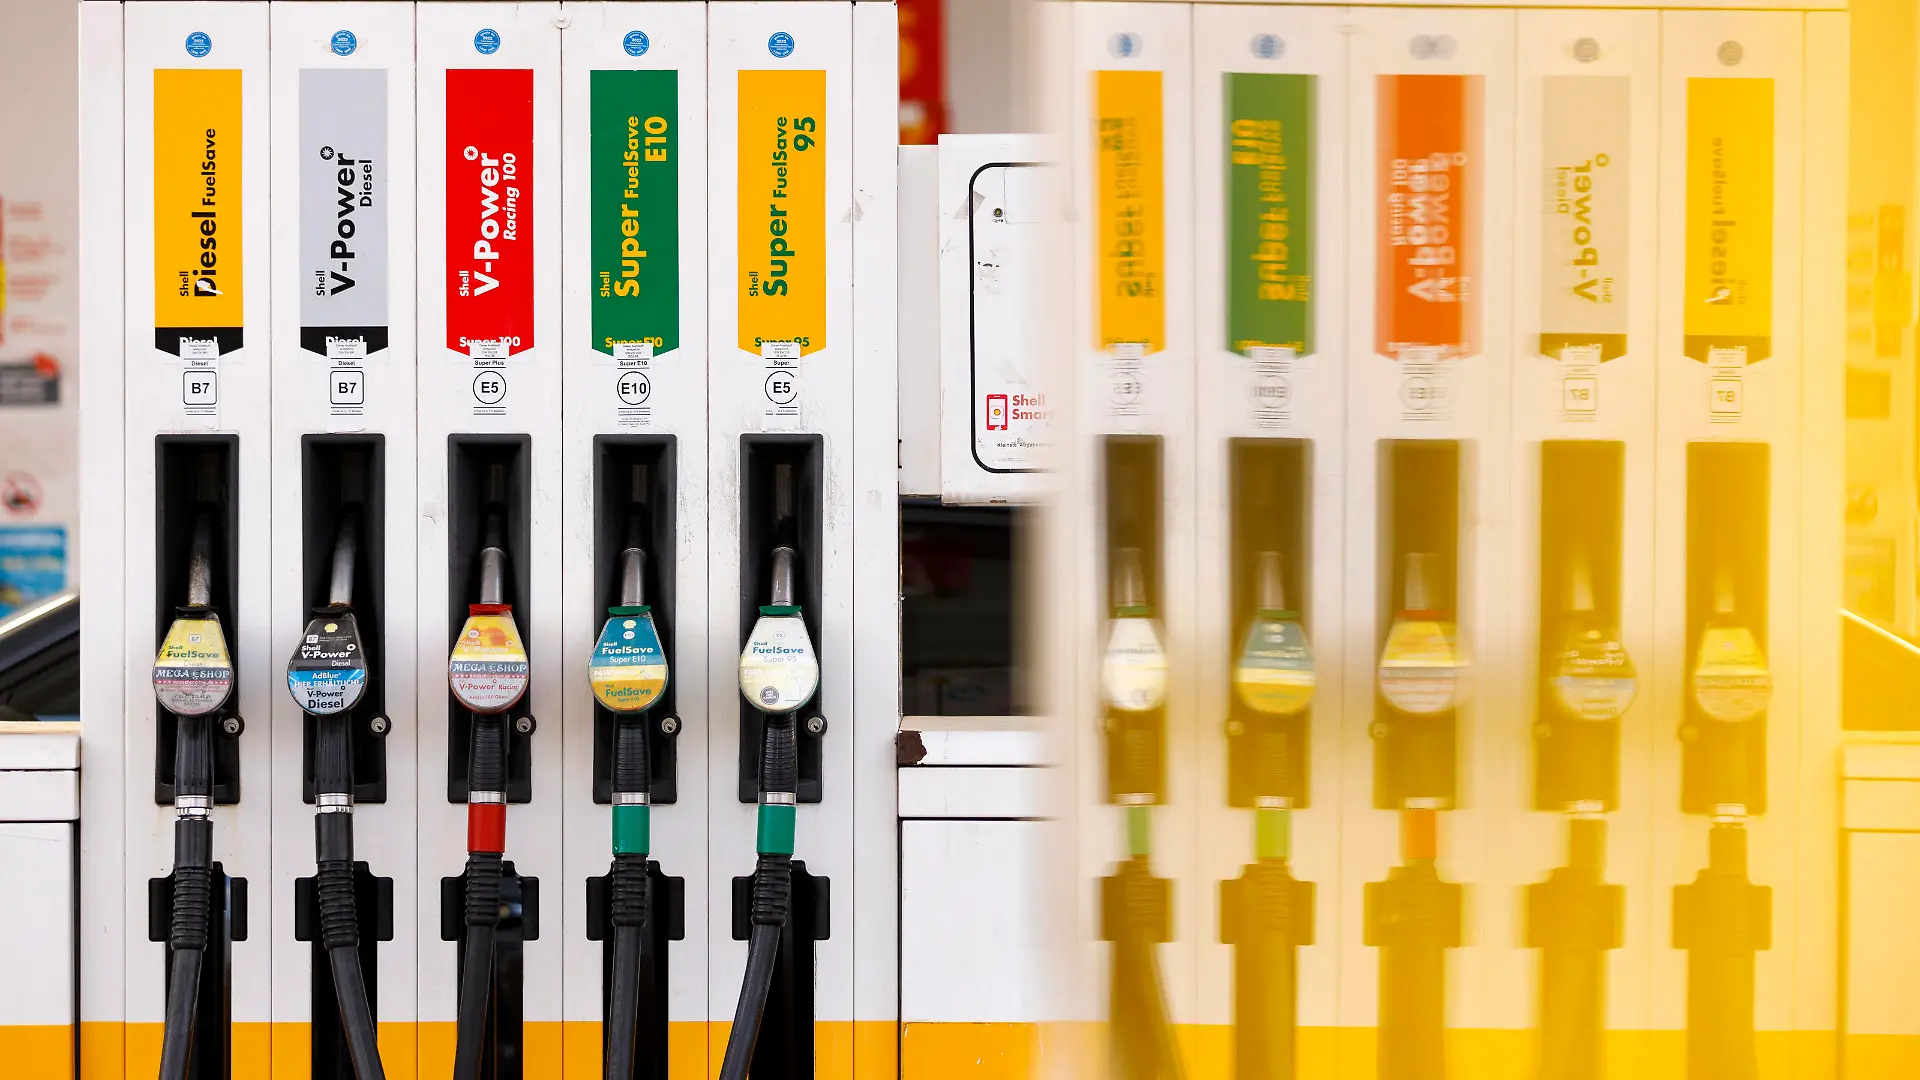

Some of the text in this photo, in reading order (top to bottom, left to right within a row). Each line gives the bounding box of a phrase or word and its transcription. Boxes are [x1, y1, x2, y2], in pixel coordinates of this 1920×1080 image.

[644, 116, 668, 162] E10
[794, 116, 816, 152] 95
[360, 160, 372, 207] Diesel
[502, 153, 520, 240] Racing 100
[614, 116, 647, 297] Super FuelSave
[763, 116, 795, 296] Super FuelSave
[192, 128, 216, 296] Diesel FuelSave
[331, 152, 356, 296] V-Power
[474, 152, 500, 296] V-Power
[180, 271, 188, 296] Shell
[316, 270, 325, 296] Shell
[459, 270, 469, 296] Shell
[600, 271, 610, 297] Shell
[749, 271, 758, 296] Shell
[192, 382, 210, 394] B7
[338, 382, 356, 394] B7
[481, 382, 498, 394] E5
[622, 382, 647, 394] E10
[773, 382, 790, 394] E5
[1012, 394, 1046, 406] Shell
[602, 646, 653, 654] FuelSave
[610, 656, 630, 664] Super
[764, 656, 784, 664] Super
[156, 670, 190, 678] MEGA
[453, 663, 486, 672] MEGA
[308, 698, 344, 708] Diesel
[606, 688, 652, 697] FuelSave
